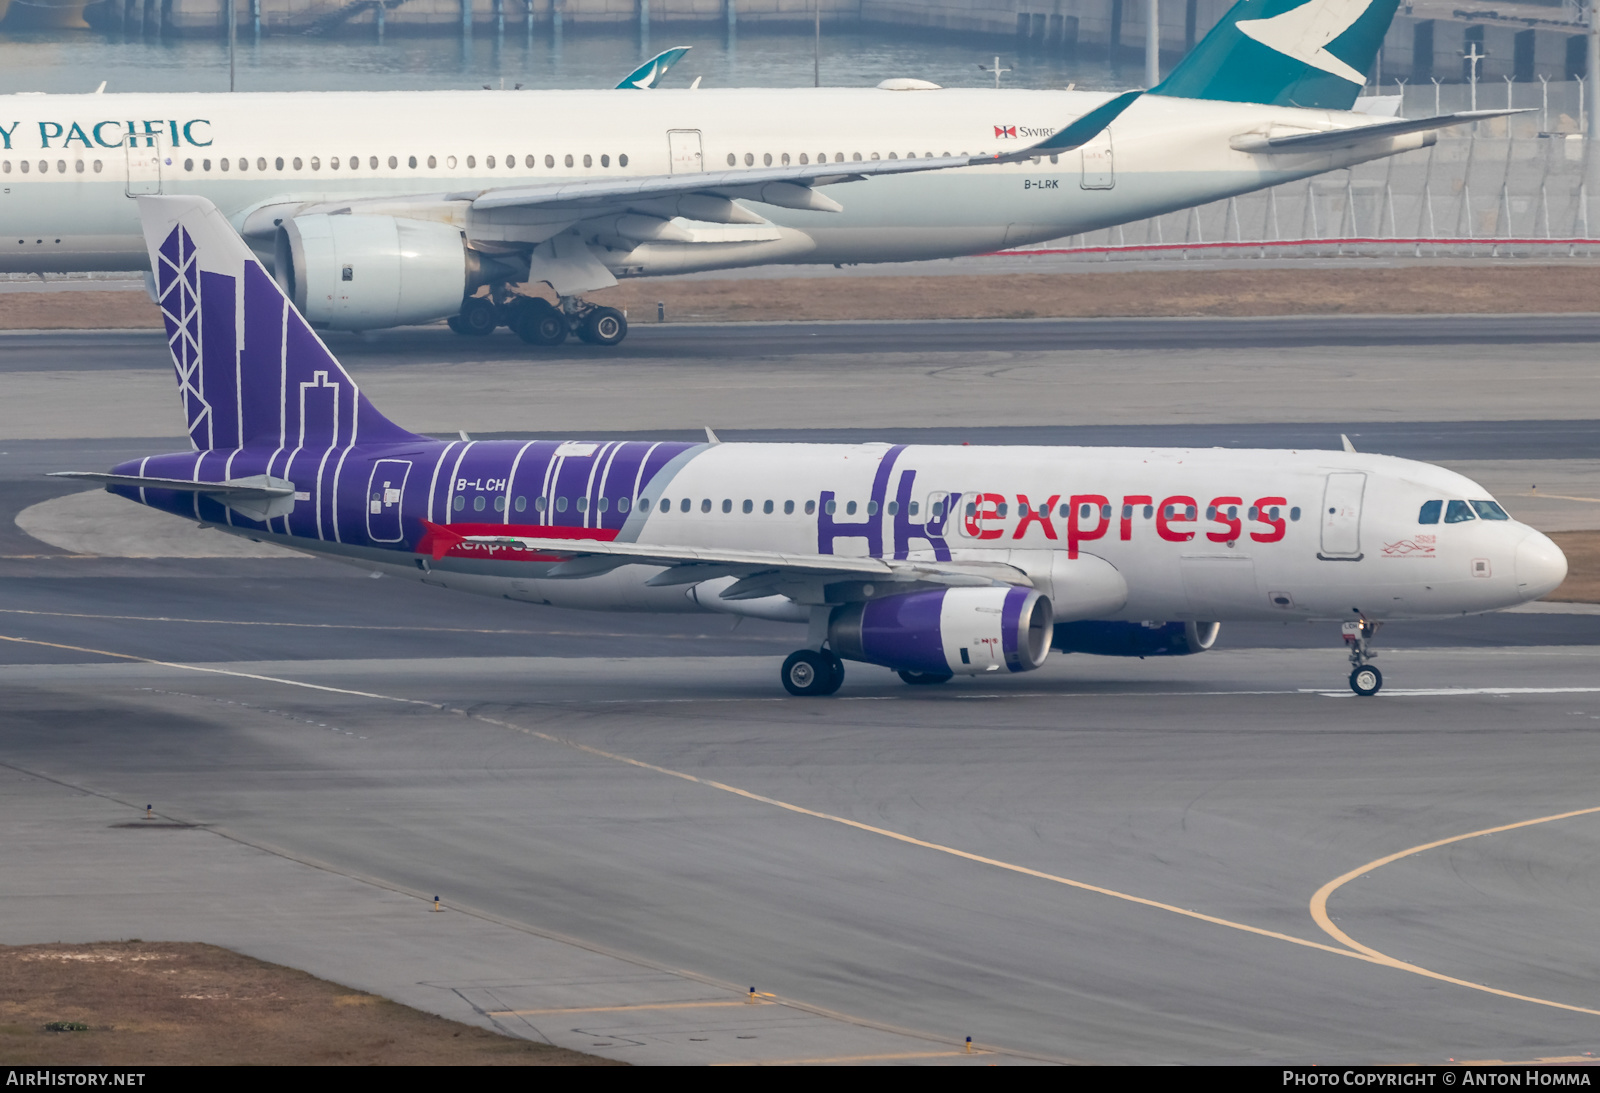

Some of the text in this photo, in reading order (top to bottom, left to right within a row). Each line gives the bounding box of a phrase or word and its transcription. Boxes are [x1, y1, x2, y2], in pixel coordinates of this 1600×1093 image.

[38, 119, 214, 148] PACIFIC
[1024, 179, 1059, 190] B-LRK
[456, 478, 506, 491] B-LCH
